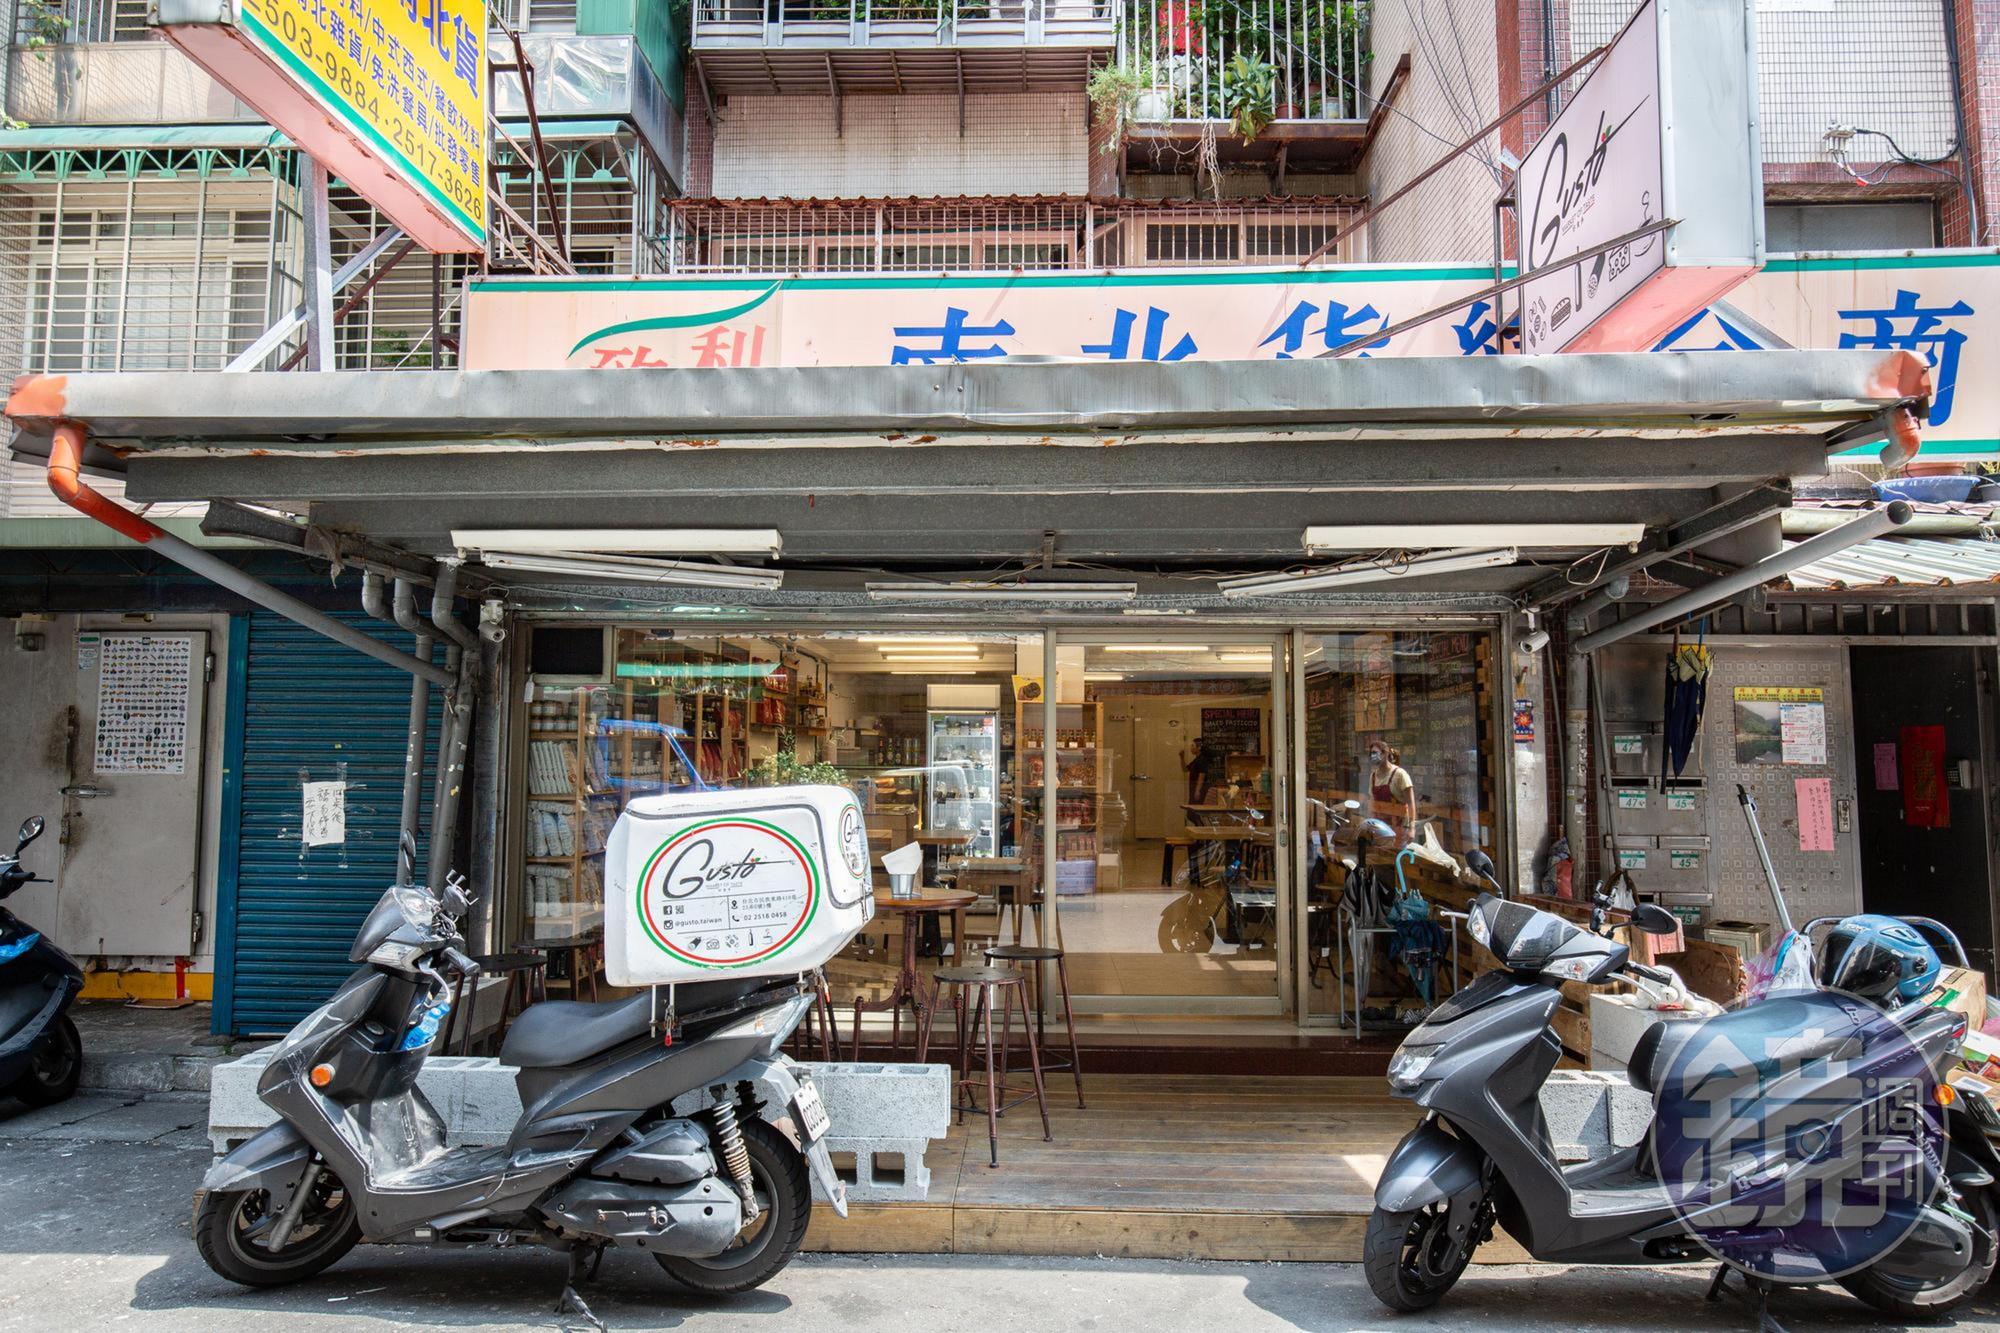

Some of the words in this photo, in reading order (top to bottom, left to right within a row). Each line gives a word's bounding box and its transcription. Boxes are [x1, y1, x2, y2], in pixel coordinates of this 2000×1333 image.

[400, 0, 481, 99] 北貨
[251, 0, 482, 221] 503-9884·2517-3626
[1529, 98, 1638, 270] Gusto
[1622, 743, 1634, 753] 47
[1626, 798, 1638, 808] 47
[662, 838, 780, 899] Gusto
[1625, 858, 1638, 868] 47
[1679, 858, 1691, 868] 45
